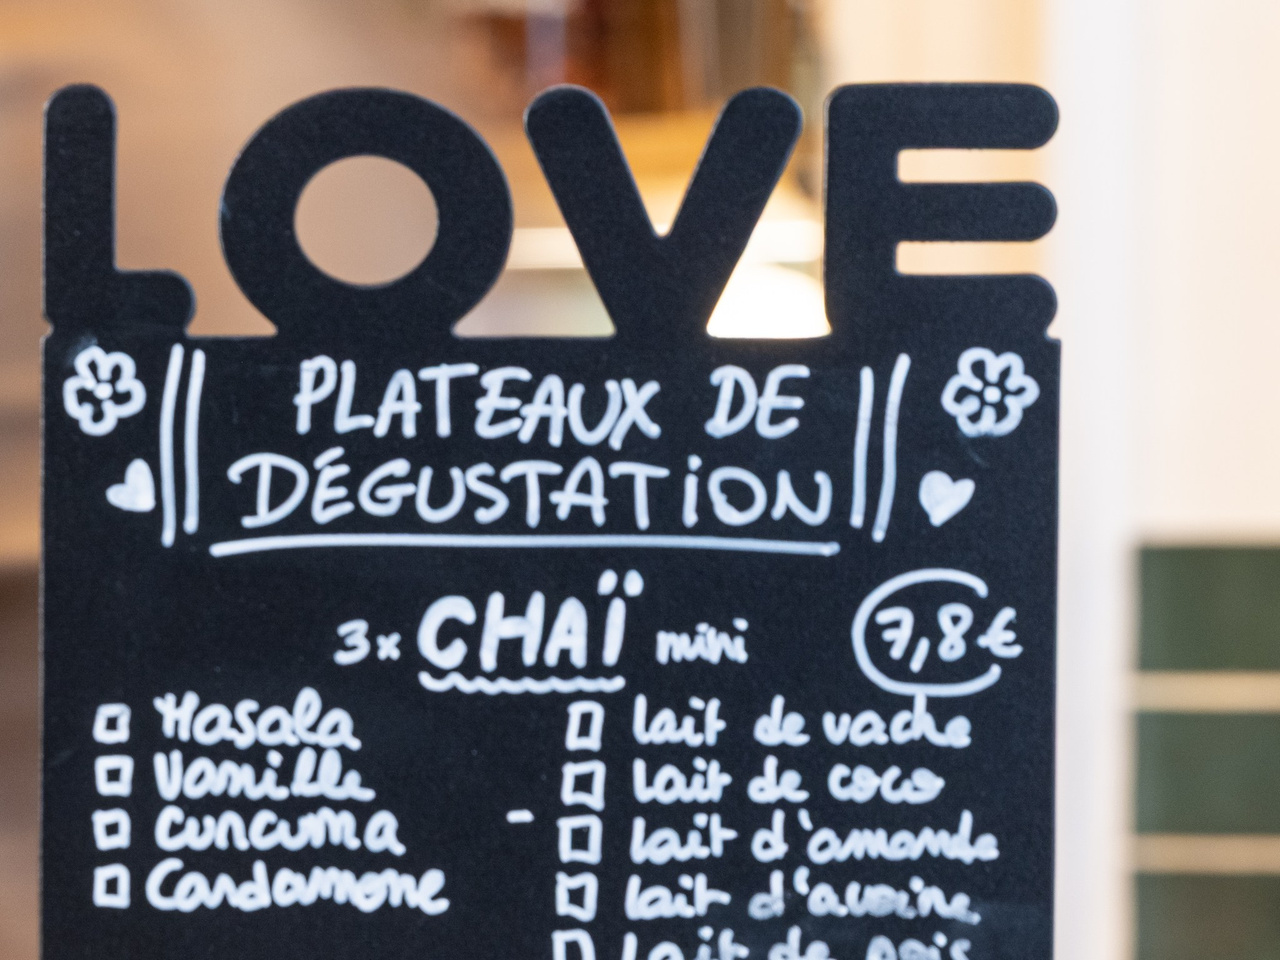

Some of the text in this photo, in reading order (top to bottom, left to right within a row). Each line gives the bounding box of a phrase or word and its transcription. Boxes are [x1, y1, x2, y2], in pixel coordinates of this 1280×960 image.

[43, 83, 1061, 338] LOVE
[294, 355, 810, 450] PLATEAUX DE
[334, 570, 748, 672] 3x CHAÏ mini
[754, 695, 810, 746] de
[822, 692, 972, 749] vache
[154, 746, 375, 801] Vanille
[748, 755, 809, 803] de
[828, 764, 945, 804] coco
[155, 805, 406, 856] Curcuma
[752, 809, 999, 863] d'amande
